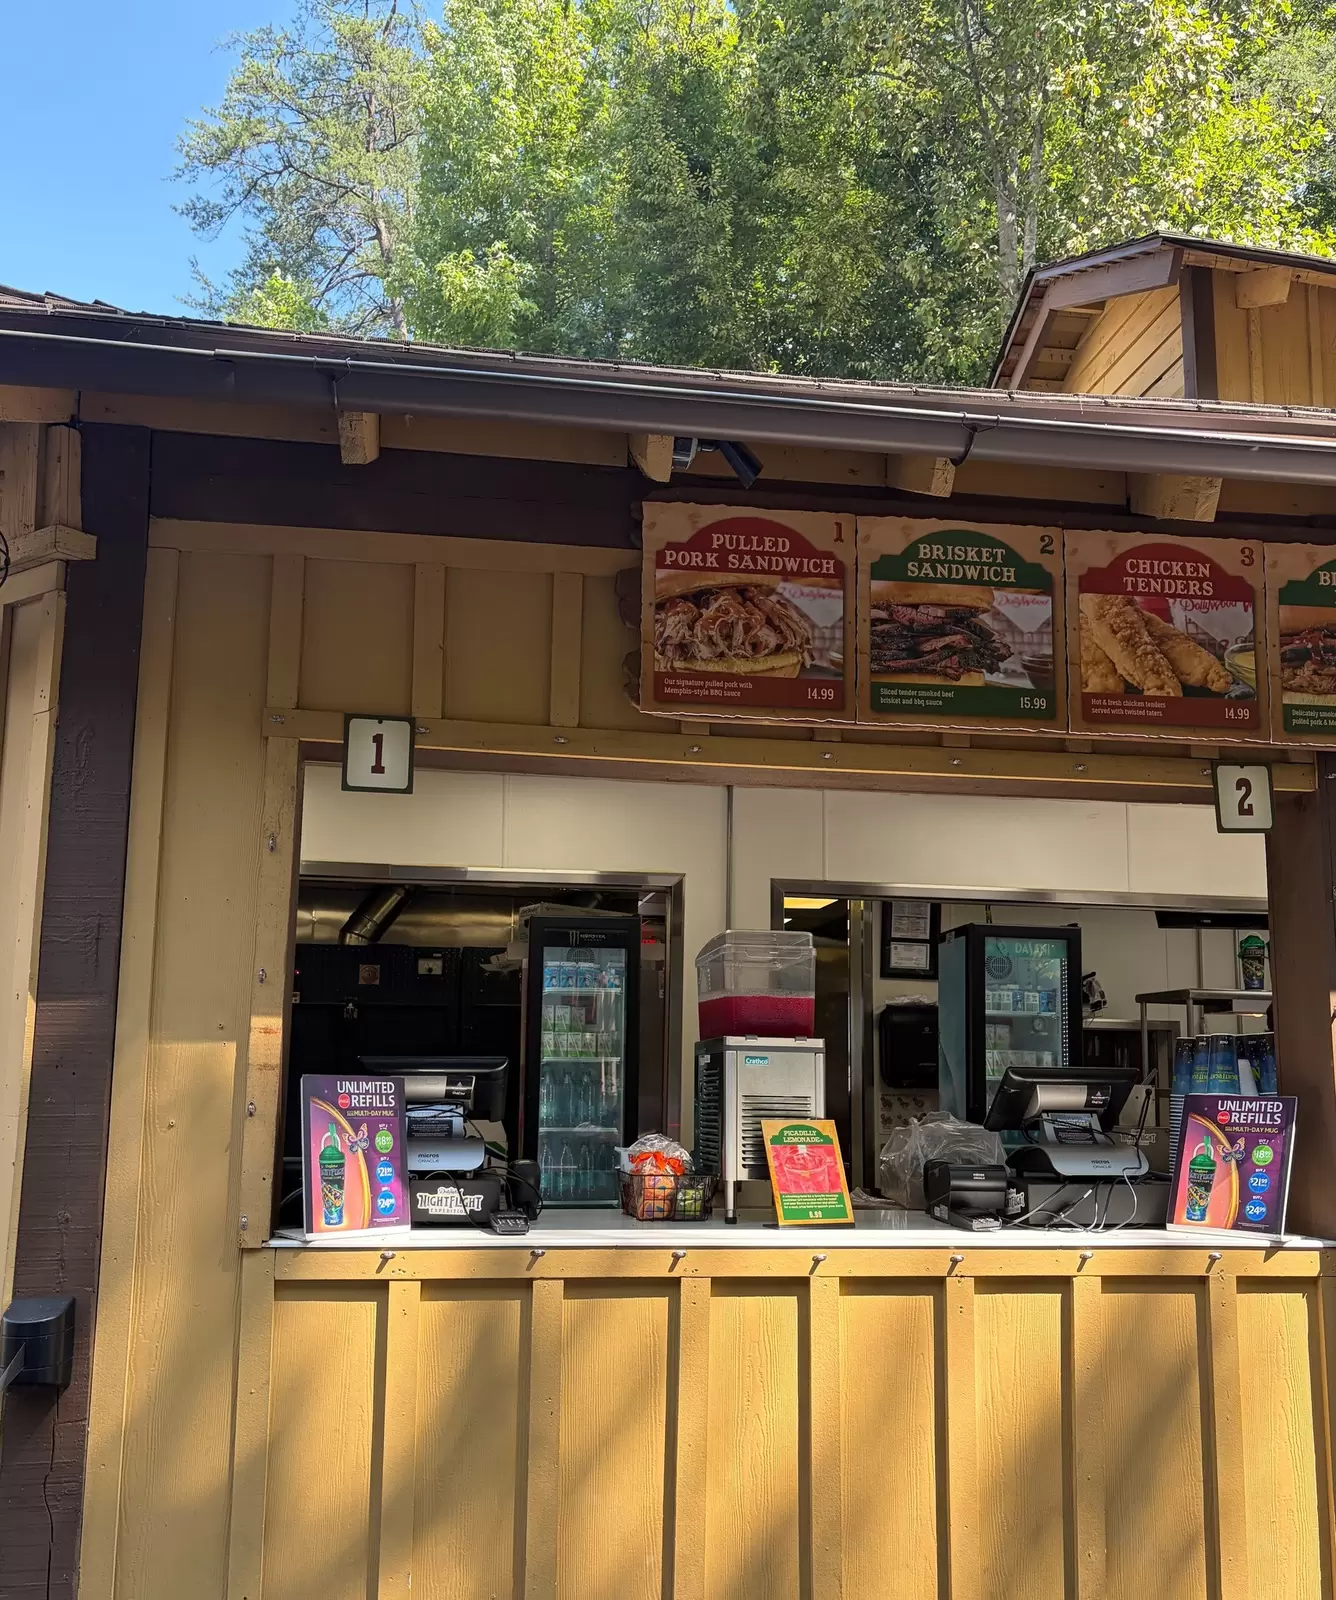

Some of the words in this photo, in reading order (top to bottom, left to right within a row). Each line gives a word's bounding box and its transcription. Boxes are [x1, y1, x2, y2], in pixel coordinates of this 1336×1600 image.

[834, 521, 844, 542] 1
[711, 533, 790, 553] PULLED
[1040, 534, 1055, 555] 2
[917, 544, 1006, 563] BRISKET
[1240, 546, 1255, 567] 3
[664, 550, 719, 568] PORK
[728, 554, 836, 574] SANDWICH
[907, 562, 1016, 582] SANDWICH
[1125, 559, 1211, 578] CHICKEN
[1123, 576, 1214, 596] TENDERS
[676, 678, 704, 687] signature
[705, 680, 724, 688] pulled
[724, 681, 738, 689] pork
[739, 681, 753, 689] with
[664, 686, 709, 696] Memphis-style
[807, 688, 834, 700] 14.99
[941, 690, 955, 698] beef
[914, 698, 925, 707] bbq
[1020, 697, 1047, 709] 15.99
[1224, 708, 1250, 720] 14.99
[1292, 709, 1318, 719] Delicately
[1292, 718, 1310, 726] pulled
[1310, 719, 1323, 727] pork
[371, 733, 385, 774] 1
[1235, 777, 1254, 816] 2
[745, 1057, 769, 1065] Crathco
[337, 1081, 395, 1093] UNLIMITED
[351, 1095, 395, 1107] REFILLS
[1217, 1100, 1283, 1113] UNLIMITED
[1230, 1112, 1282, 1124] REFILLS
[419, 1194, 482, 1210] NIGHTFLGHT
